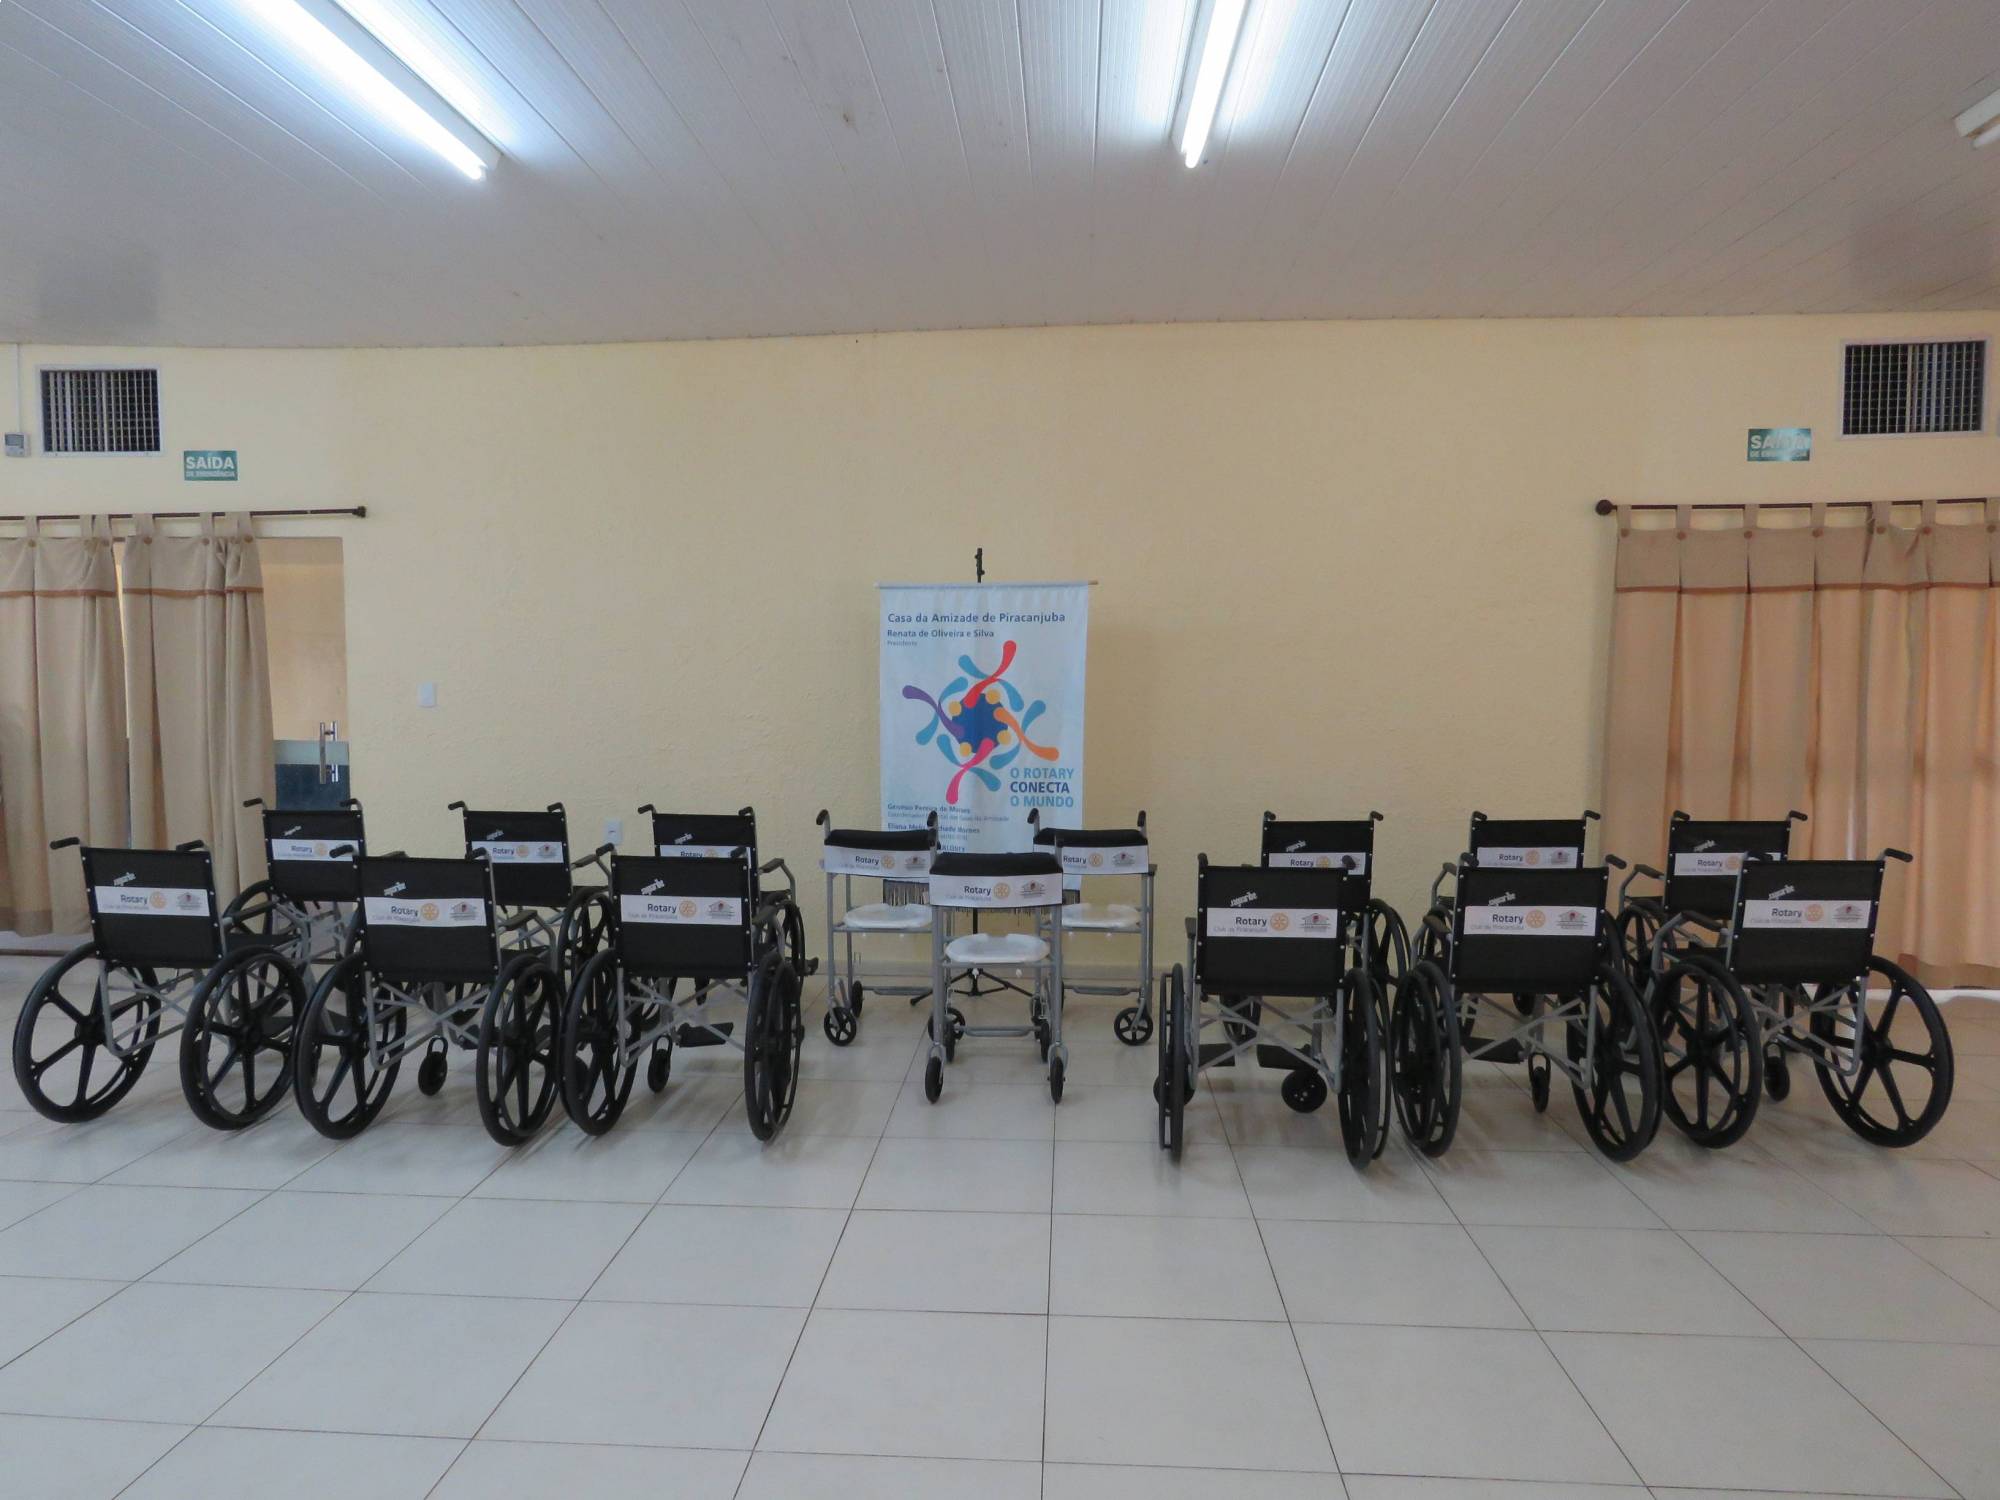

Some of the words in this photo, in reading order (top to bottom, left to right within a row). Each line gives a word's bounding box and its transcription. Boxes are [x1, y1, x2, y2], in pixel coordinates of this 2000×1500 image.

[888, 613, 913, 623] Casa
[916, 613, 928, 623] da
[931, 613, 979, 623] Amizade
[982, 613, 996, 623] de
[999, 613, 1066, 625] Piracanjuba
[887, 630, 917, 638] Renata
[919, 630, 929, 638] de
[931, 630, 964, 638] Oliveira
[973, 629, 994, 638] Silva
[1010, 767, 1019, 779] O
[1024, 767, 1074, 779] ROTARY
[1010, 781, 1070, 793] CONECTA
[1010, 795, 1019, 807] O
[1024, 795, 1074, 808] MUNDO
[492, 847, 514, 855] Rotary
[856, 856, 880, 865] Rotary
[1063, 855, 1087, 864] Rotary
[1290, 859, 1314, 867] Rotary
[964, 886, 991, 896] Rotary
[391, 906, 418, 917] Rotary
[648, 904, 677, 914] Rotary
[1771, 908, 1802, 918] Rotary
[1235, 916, 1267, 927] Rotary
[1492, 914, 1524, 924] Rotary
